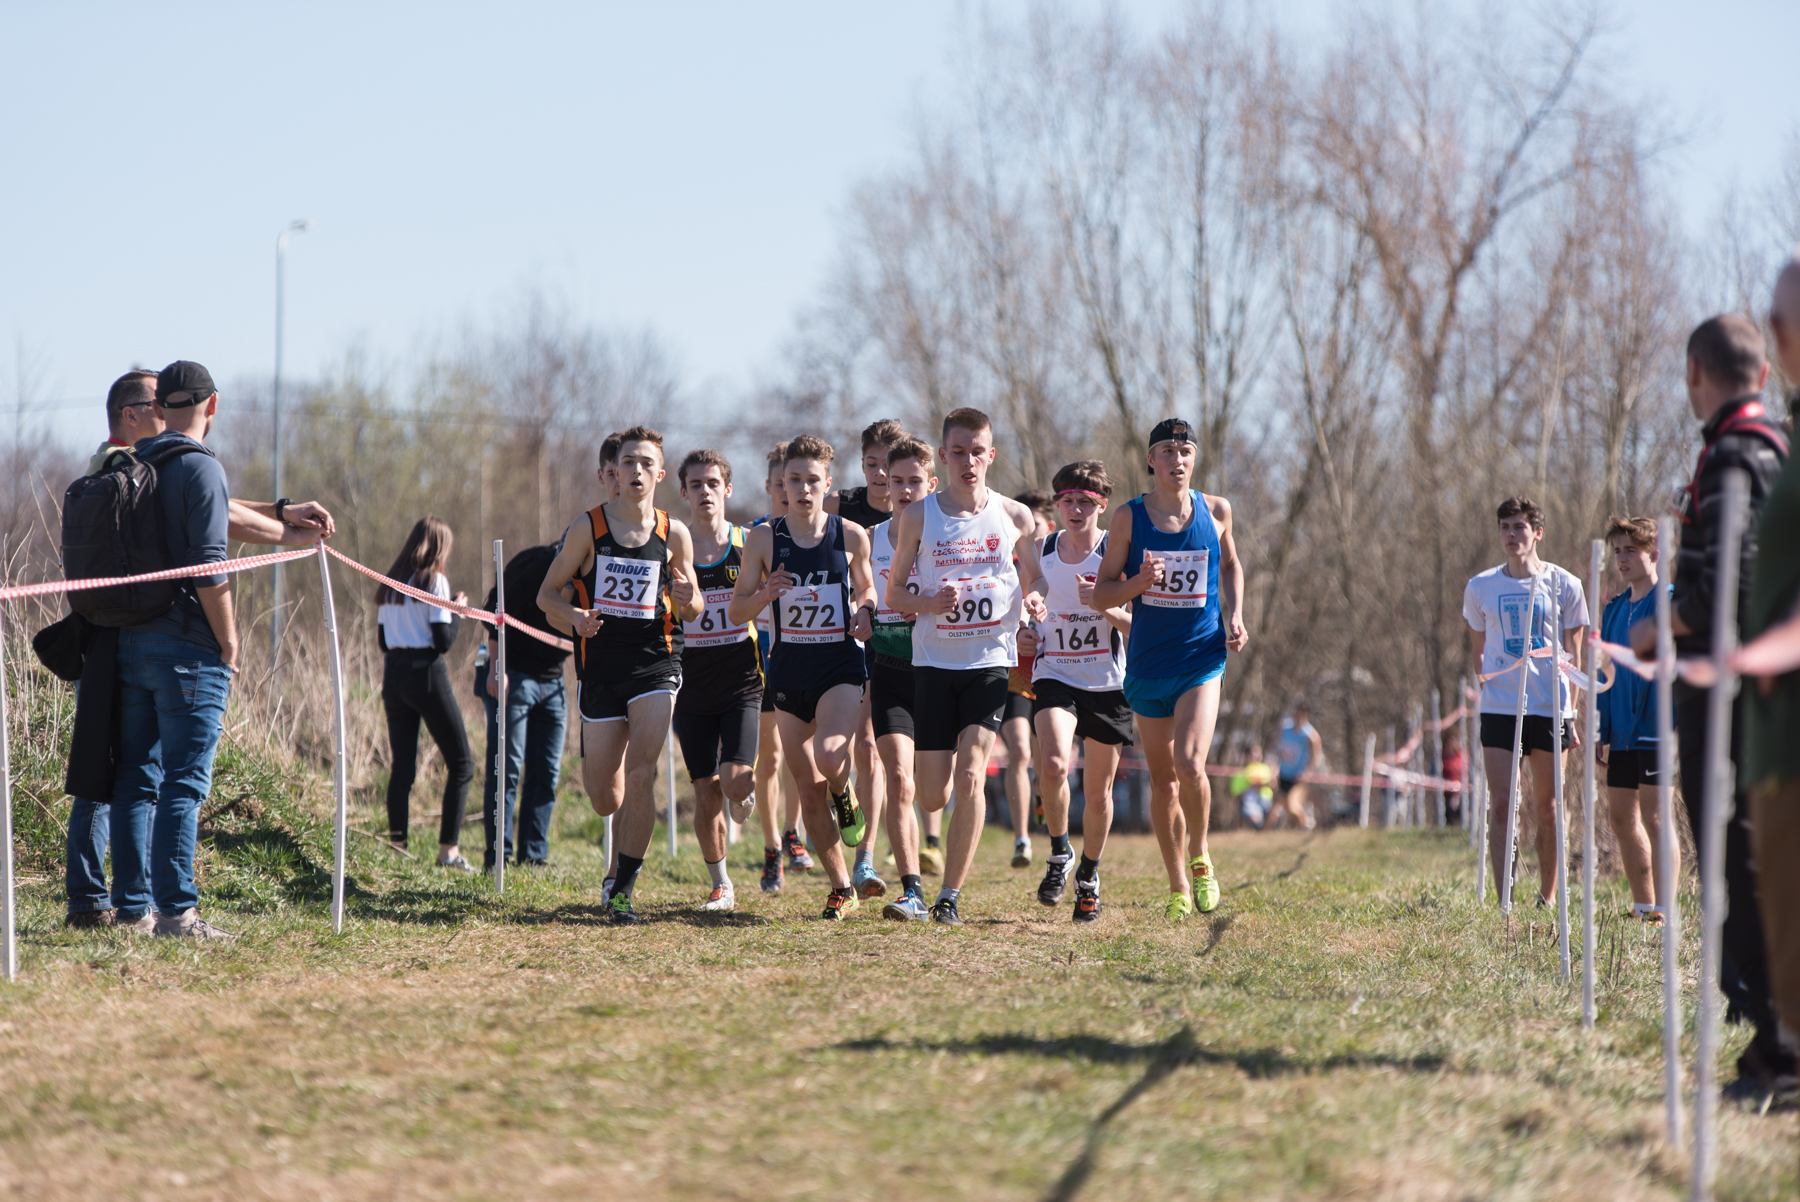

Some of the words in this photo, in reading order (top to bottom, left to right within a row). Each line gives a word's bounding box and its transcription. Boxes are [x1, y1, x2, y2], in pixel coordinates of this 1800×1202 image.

[602, 575, 651, 603] 237
[1154, 569, 1199, 593] 459
[602, 607, 628, 616] OLSZYNA
[945, 597, 993, 624] 390
[1153, 598, 1180, 607] OLSZYNA
[700, 607, 727, 632] 61
[788, 603, 836, 628] 272
[1055, 626, 1099, 651] 164
